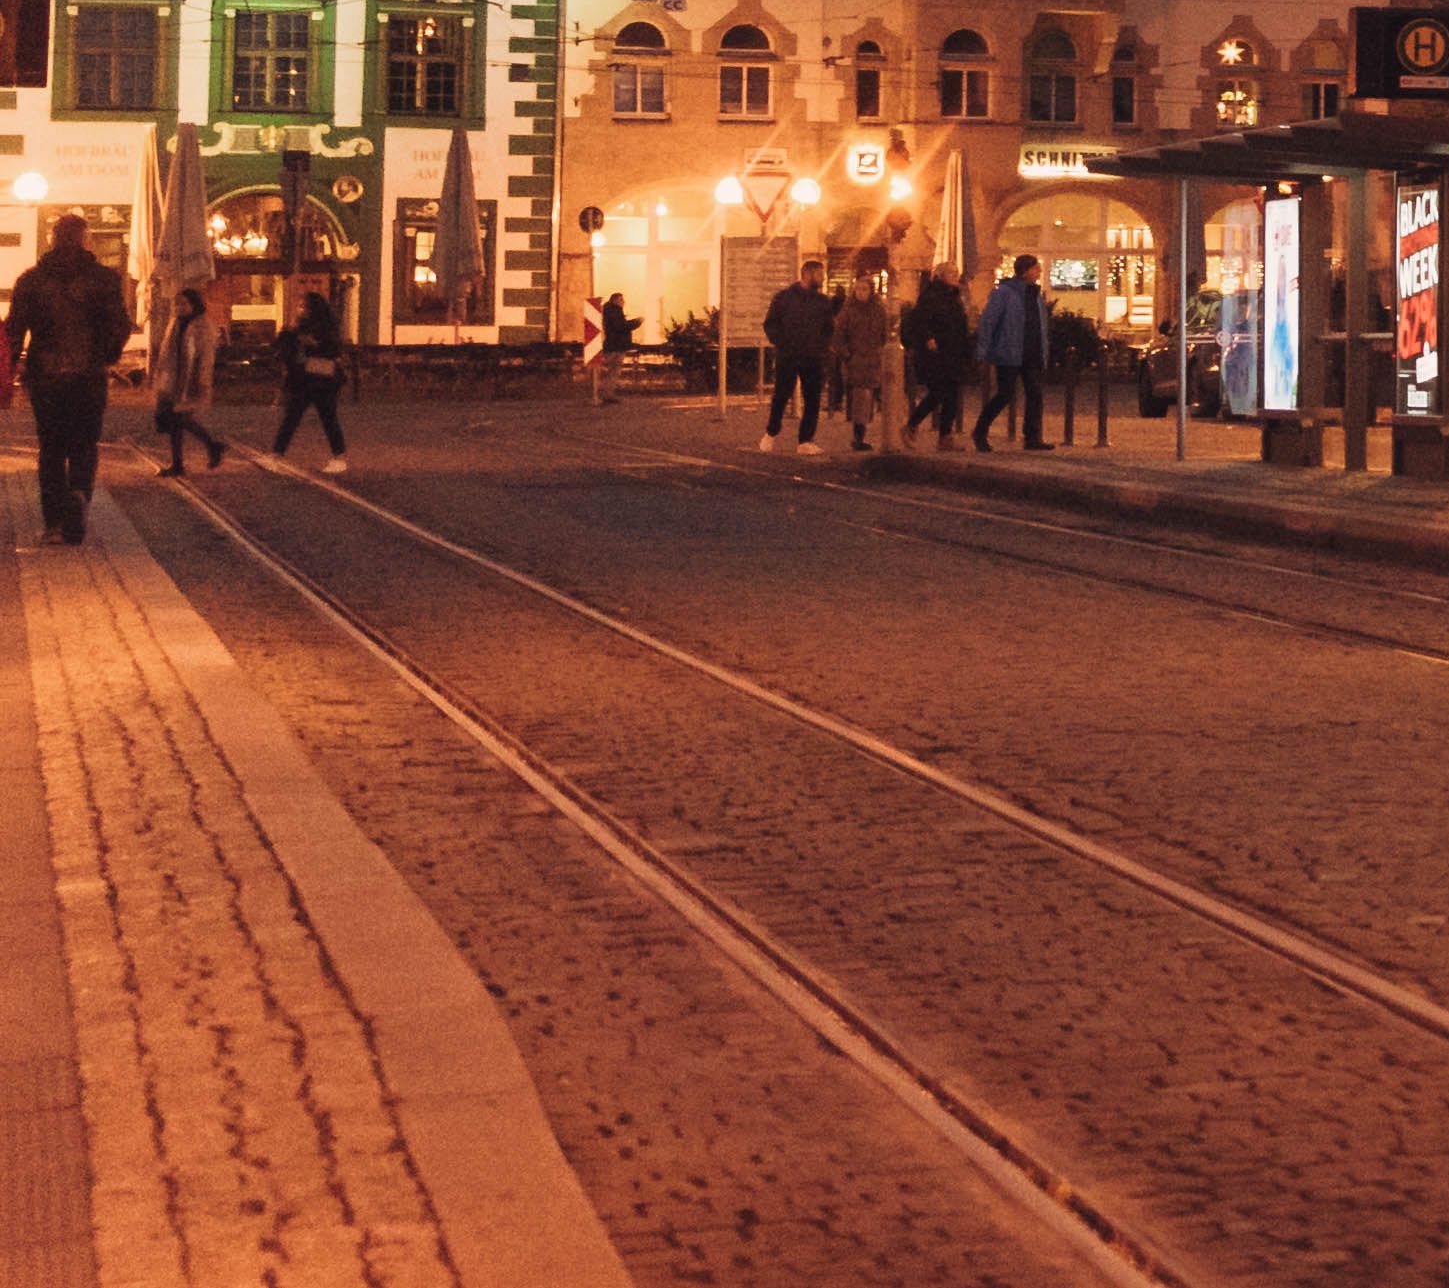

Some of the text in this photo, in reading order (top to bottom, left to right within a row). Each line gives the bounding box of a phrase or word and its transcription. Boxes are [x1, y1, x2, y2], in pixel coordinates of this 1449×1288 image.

[1413, 31, 1436, 62] H
[1401, 189, 1439, 238] BLACK
[1400, 243, 1439, 300] WEEK
